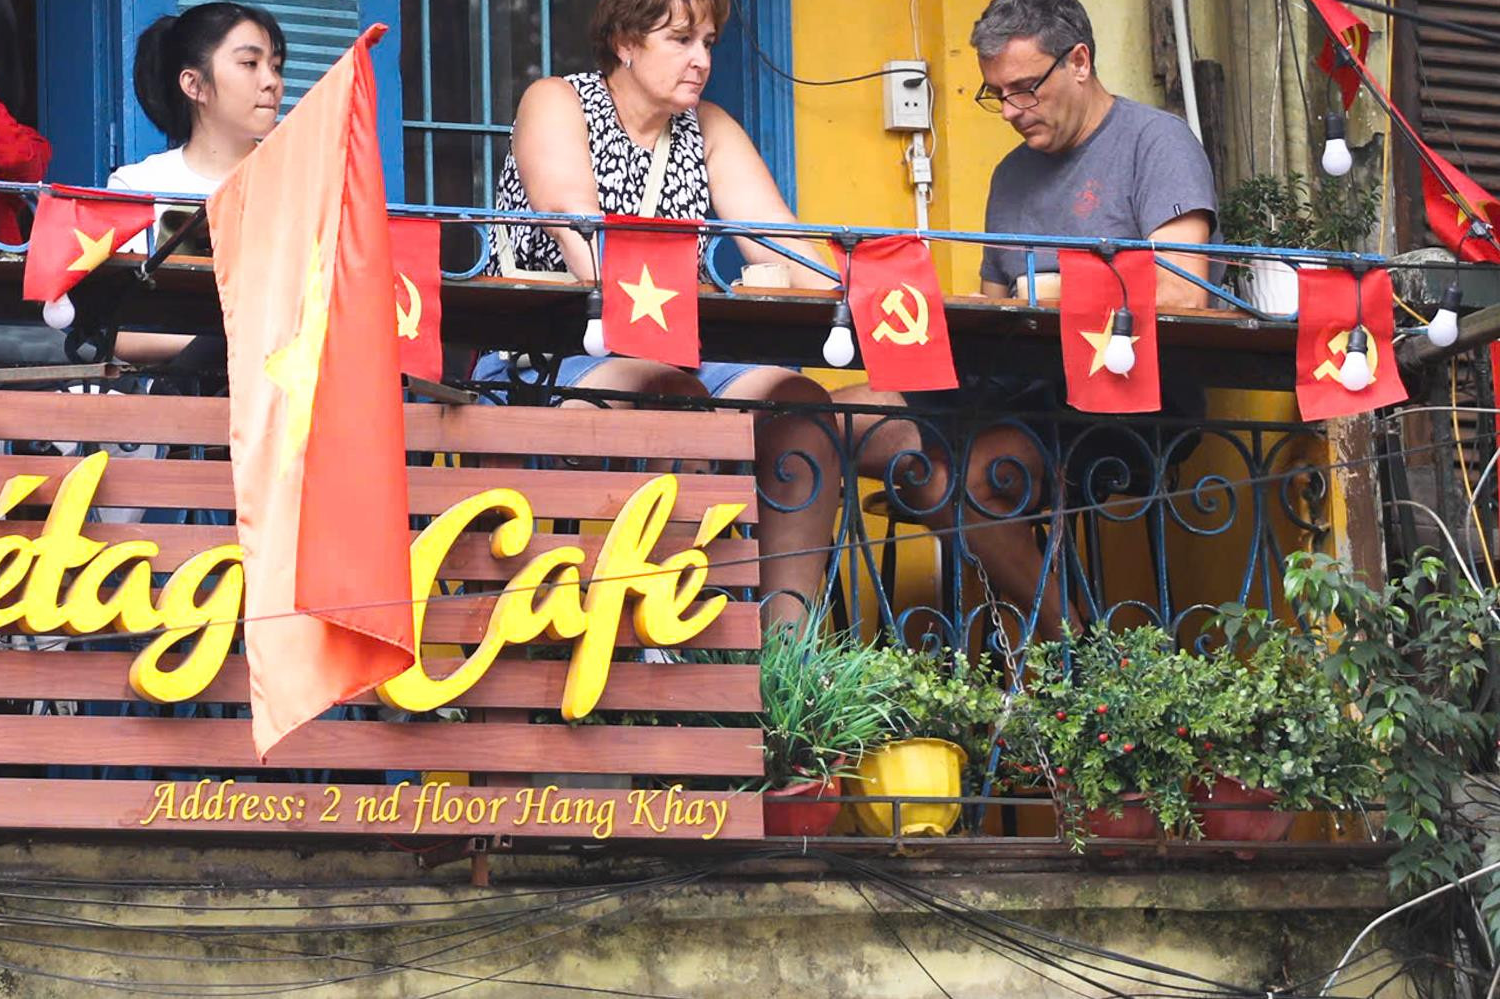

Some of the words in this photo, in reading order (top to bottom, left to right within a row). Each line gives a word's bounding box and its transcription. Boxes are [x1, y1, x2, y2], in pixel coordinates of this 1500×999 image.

[376, 472, 749, 721] Café
[139, 778, 307, 826] Address:
[318, 785, 343, 823] 2
[354, 781, 410, 823] nd
[411, 778, 509, 835] floor
[512, 785, 617, 841] Hang
[627, 784, 730, 841] Khay
